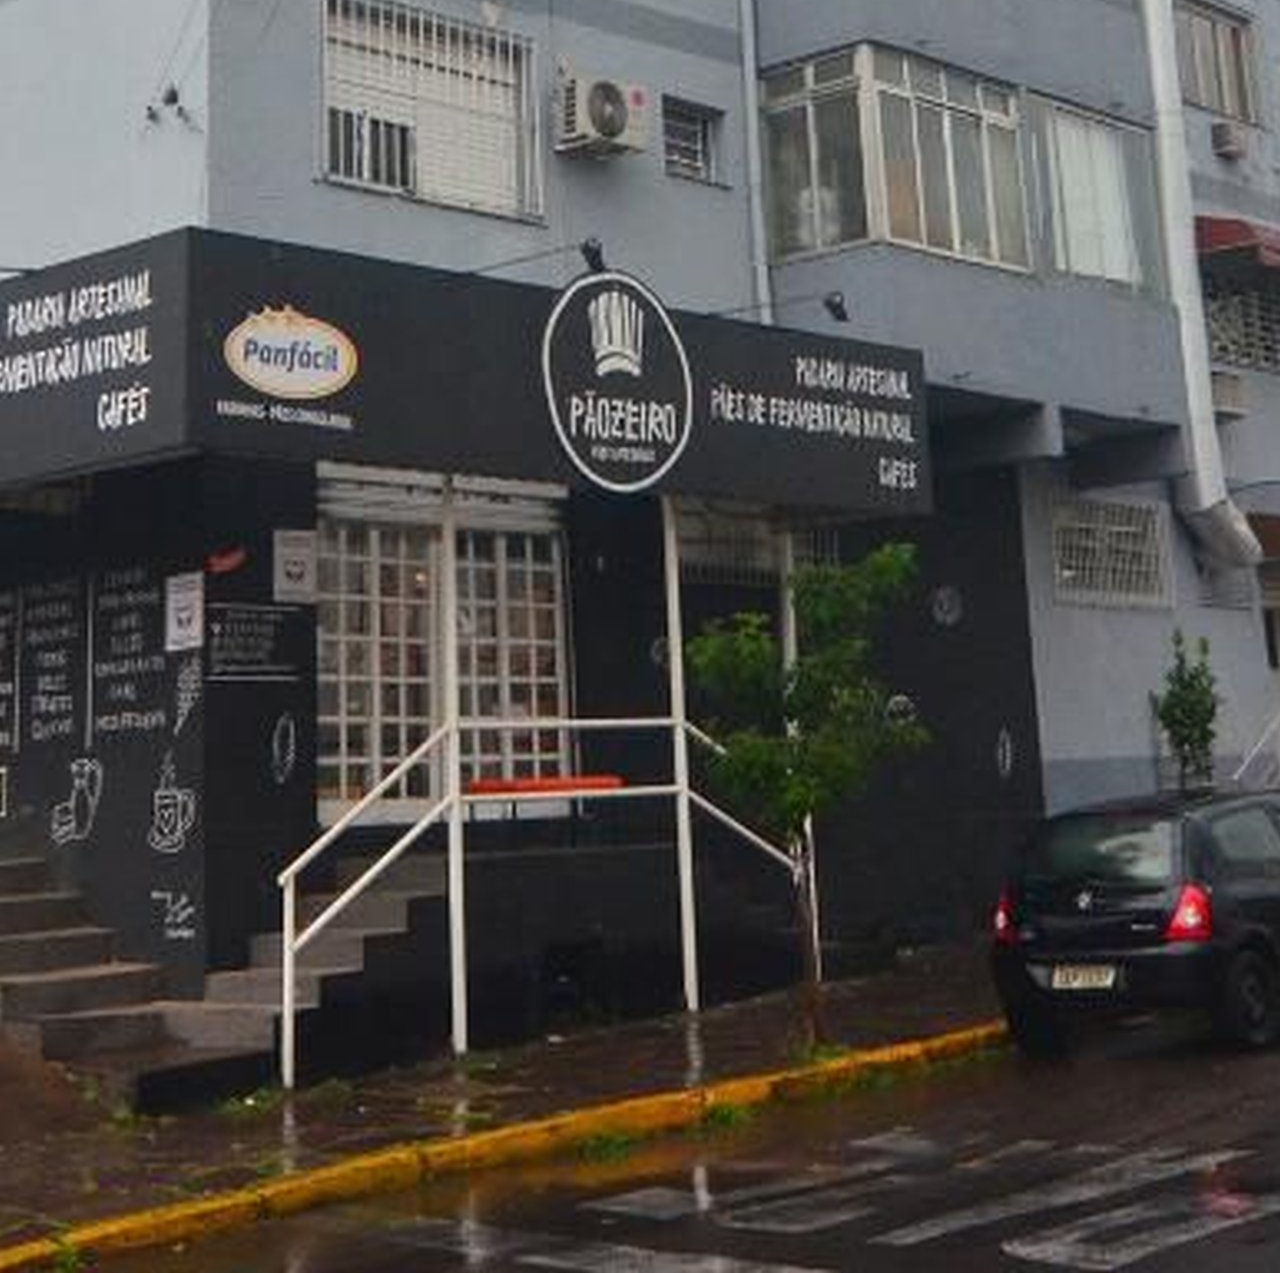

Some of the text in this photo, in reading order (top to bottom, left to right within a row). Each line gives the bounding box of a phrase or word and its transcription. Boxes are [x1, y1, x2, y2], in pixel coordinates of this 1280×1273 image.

[68, 269, 153, 326] ARTESANAL
[81, 326, 153, 376] NATURAL
[243, 337, 339, 373] Panfácil
[570, 389, 677, 445] PÃOZEIRO
[746, 391, 767, 426] DE
